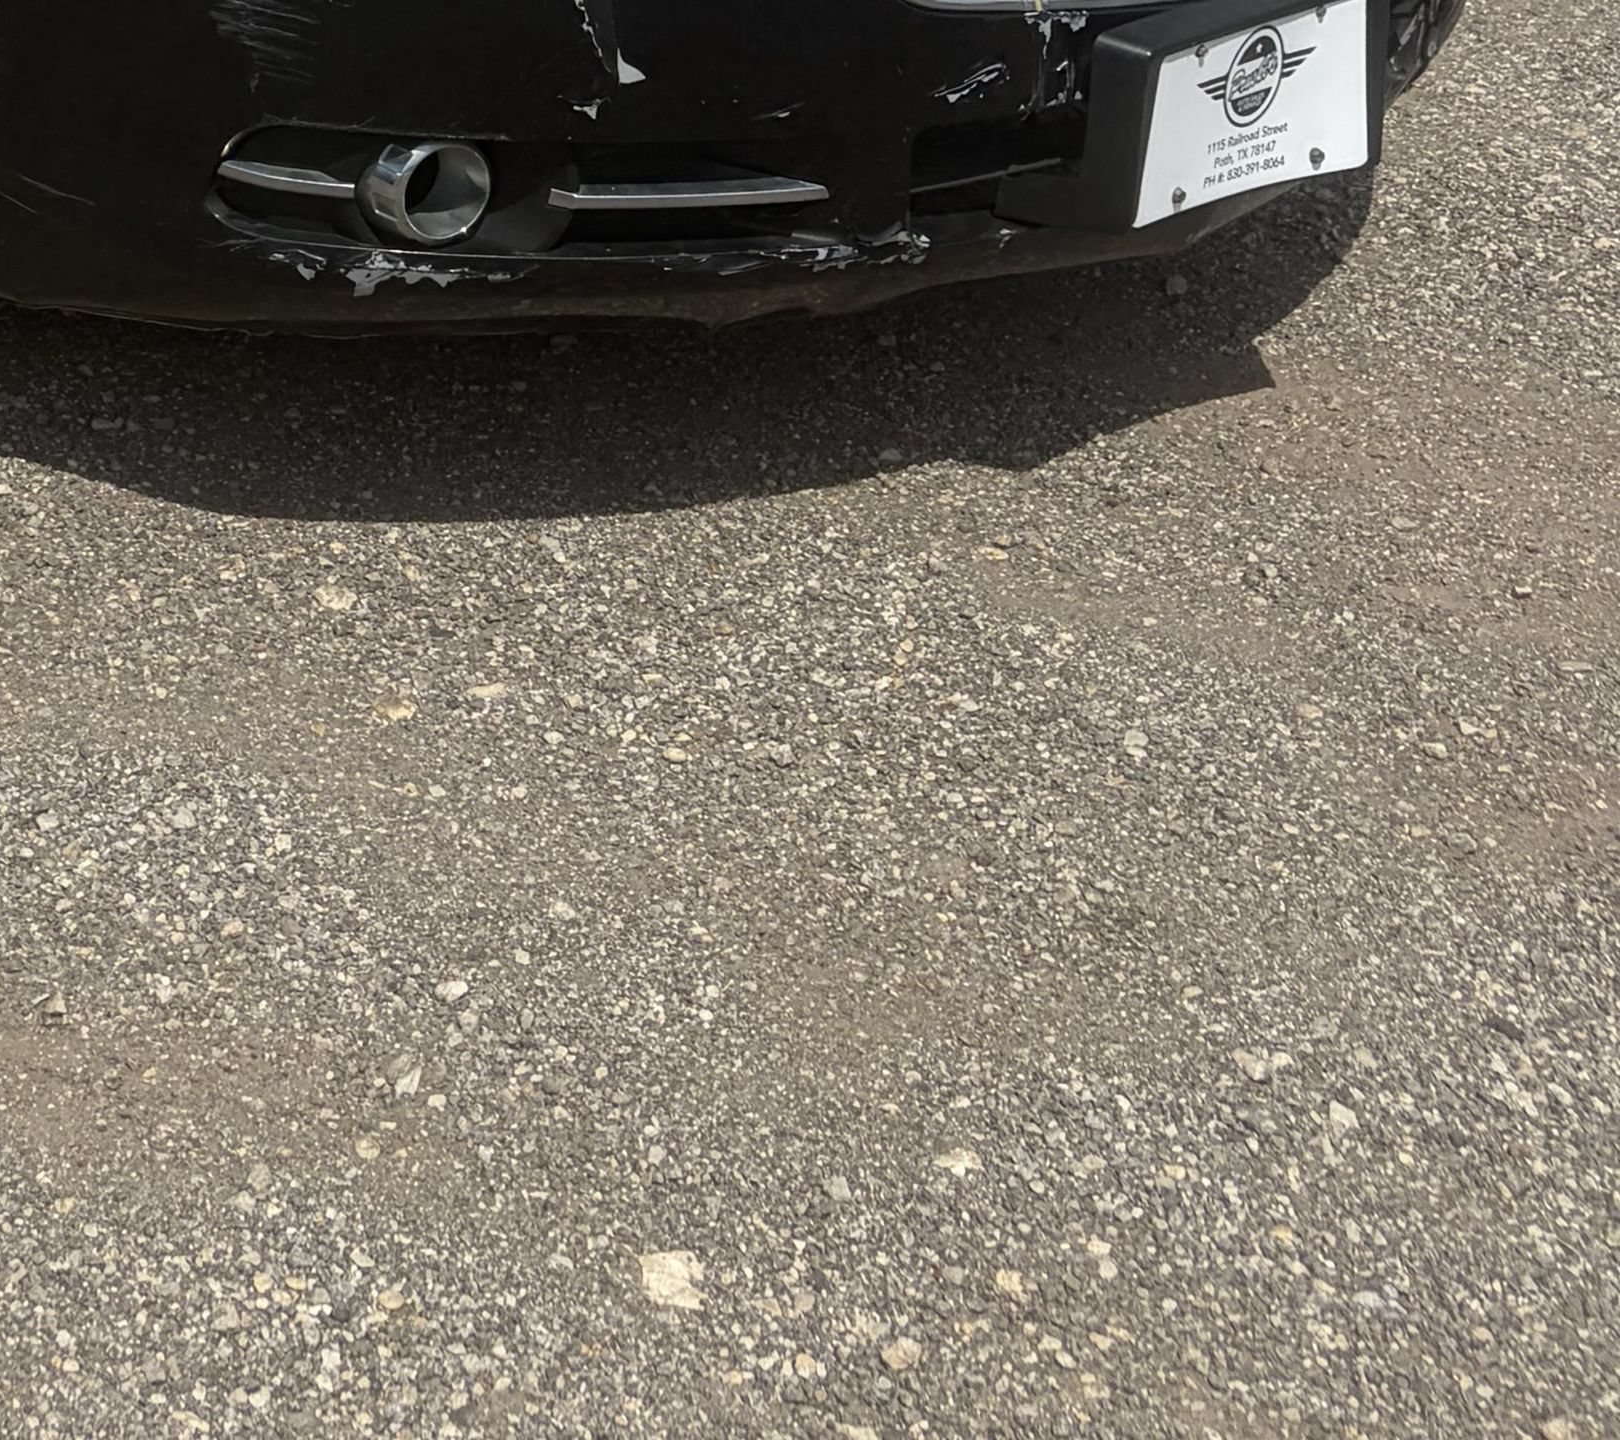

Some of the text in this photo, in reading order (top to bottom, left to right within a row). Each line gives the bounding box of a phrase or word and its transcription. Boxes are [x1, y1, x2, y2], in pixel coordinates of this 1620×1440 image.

[1207, 122, 1288, 155] 1115 Railroad Street
[1237, 147, 1249, 161] TX
[1250, 139, 1276, 158] 78147
[1203, 175, 1216, 189] PH
